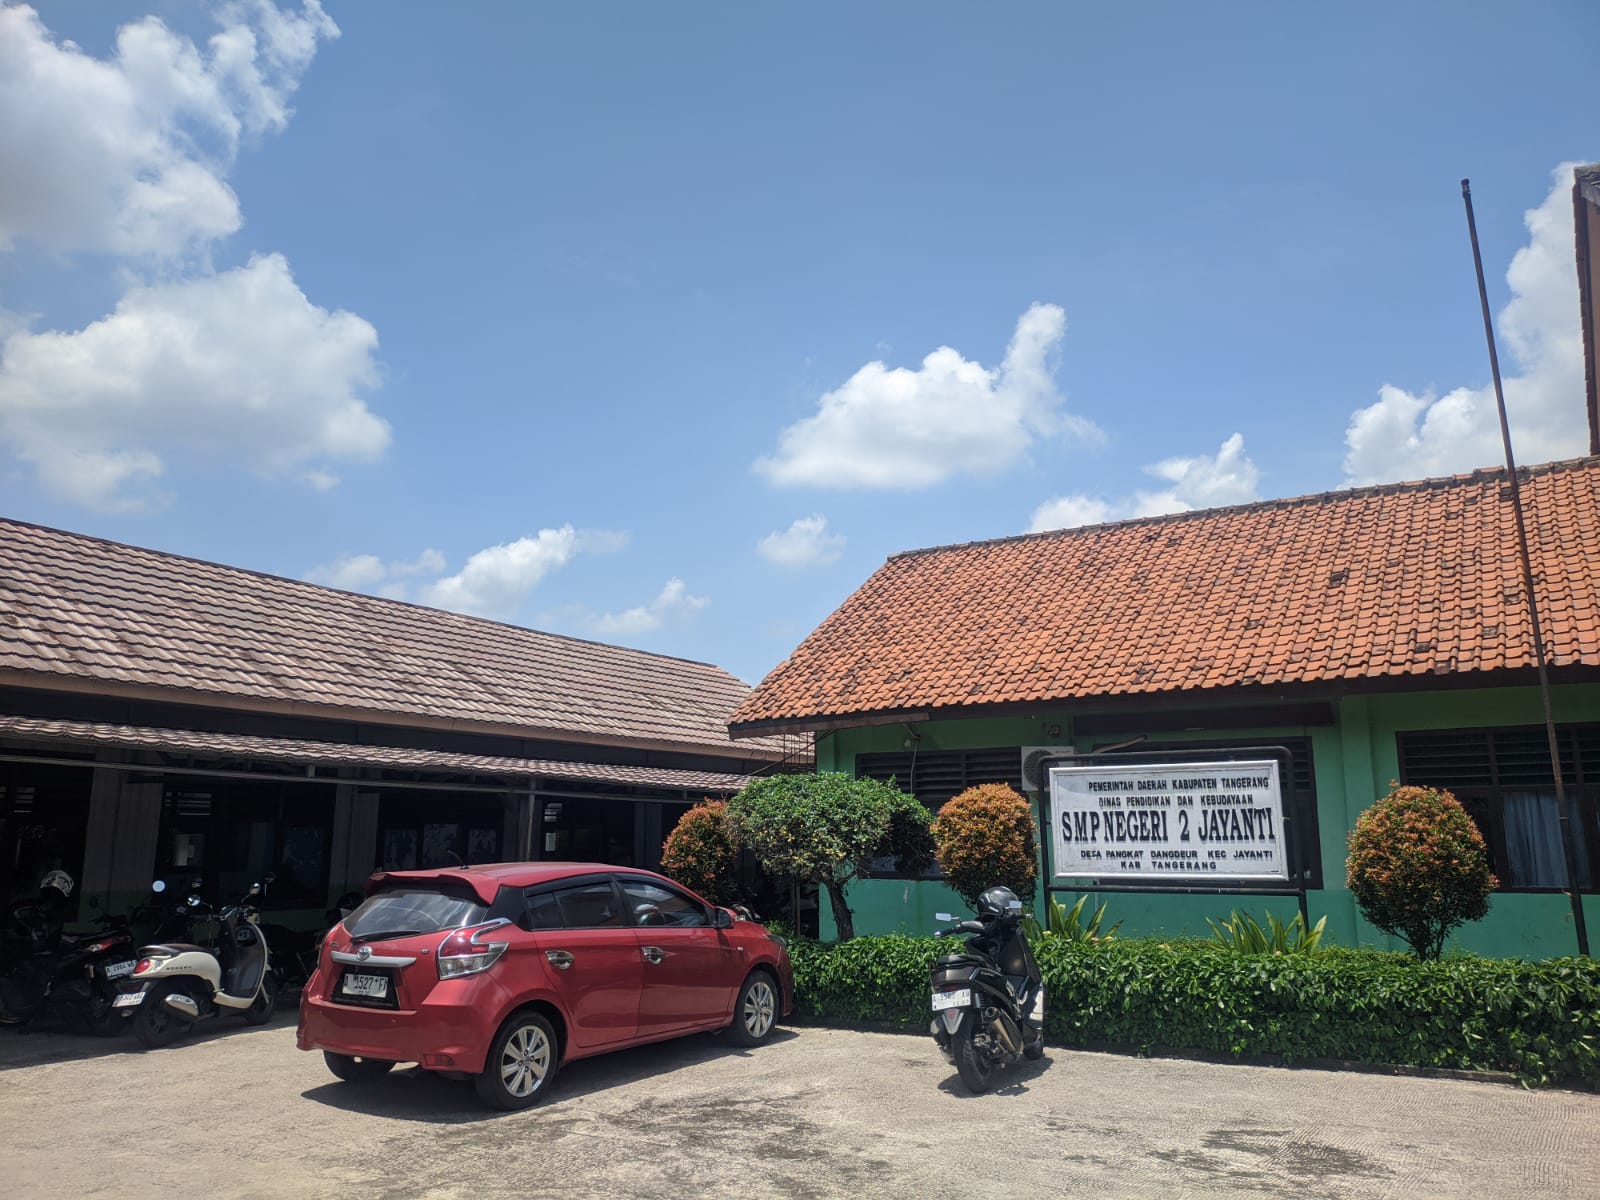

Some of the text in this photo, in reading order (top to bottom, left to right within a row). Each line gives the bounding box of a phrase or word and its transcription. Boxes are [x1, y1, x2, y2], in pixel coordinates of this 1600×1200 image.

[1088, 776, 1269, 792] PEMERINTAH DAERAH KABUPATEN TANGERANG
[1099, 794, 1254, 807] DINAS PENDIDIKAN DAN KEBUDAYAAN
[1179, 809, 1190, 842] 2
[1198, 807, 1275, 841] JAYANTI
[1080, 850, 1102, 859] DESA
[1208, 850, 1227, 859] KEC
[1233, 850, 1273, 859] JAYANTI
[1121, 861, 1217, 870] KAB TANGERANG
